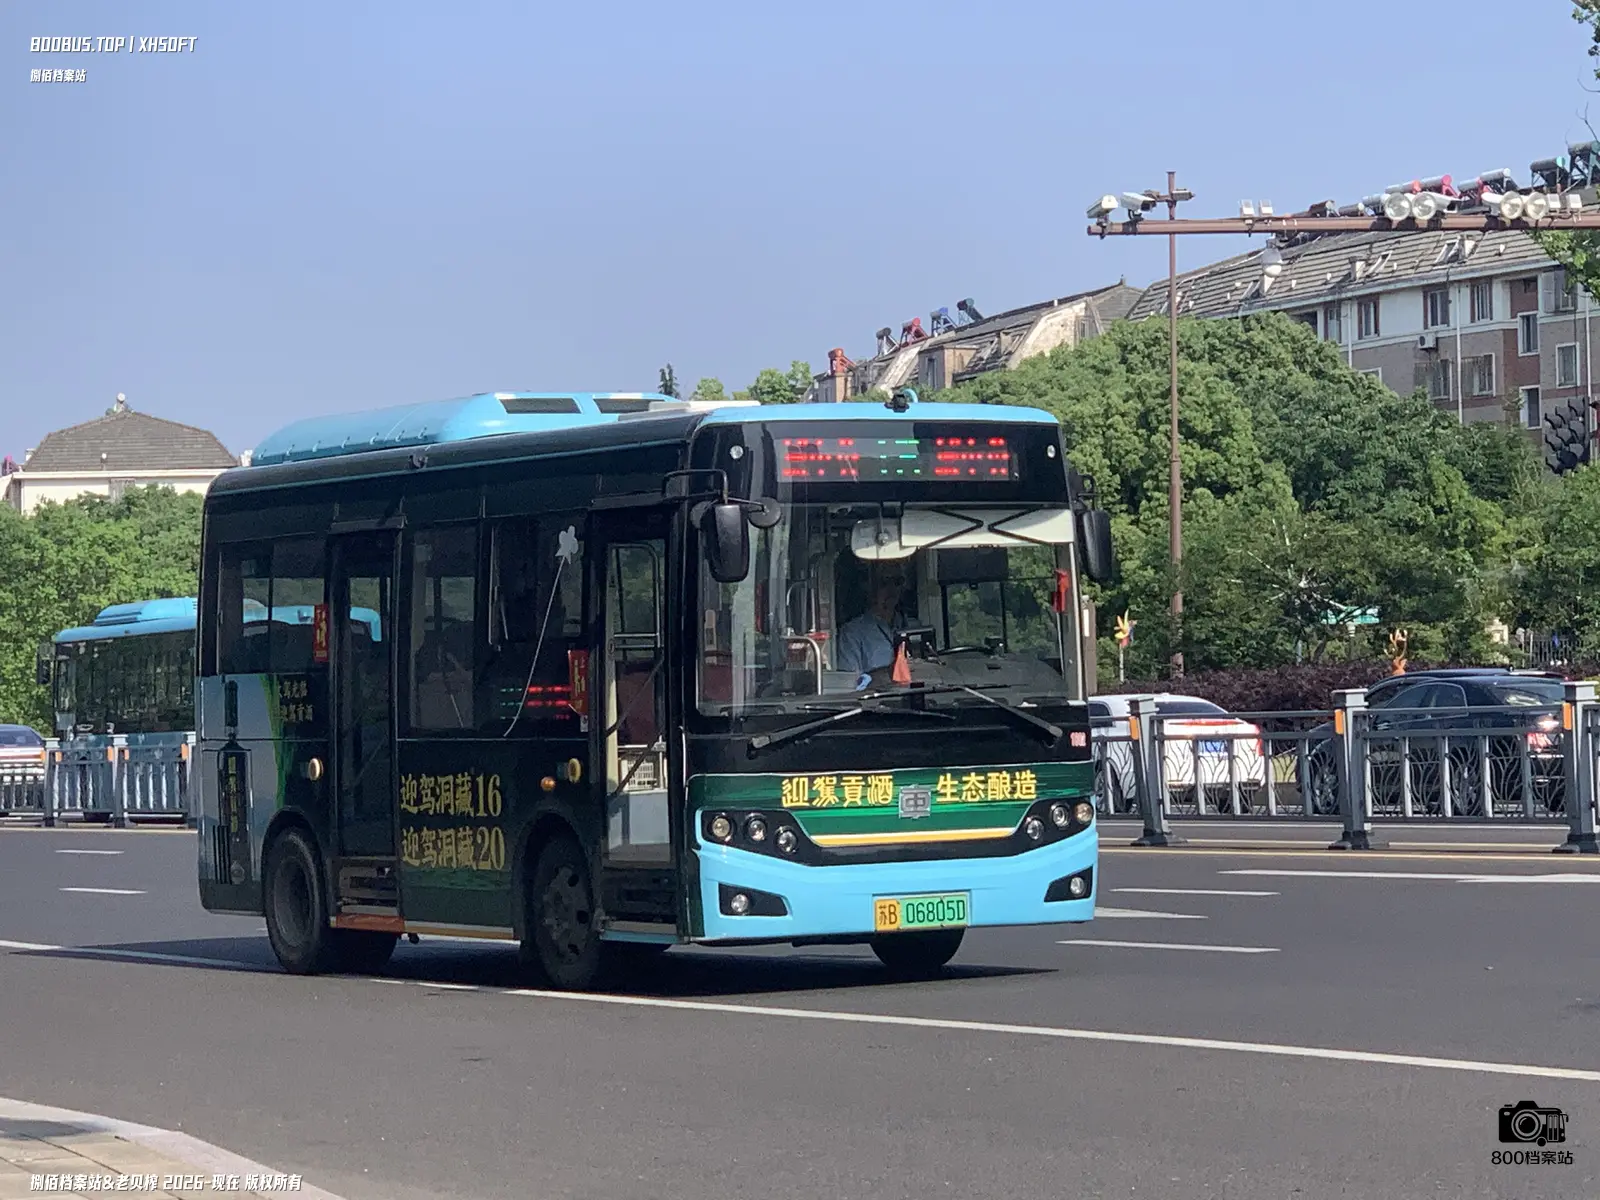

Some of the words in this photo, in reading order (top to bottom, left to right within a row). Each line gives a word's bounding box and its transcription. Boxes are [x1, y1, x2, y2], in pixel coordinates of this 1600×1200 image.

[935, 769, 1038, 803] 生态酿造
[878, 903, 898, 926] 苏B
[905, 899, 966, 924] 06805D
